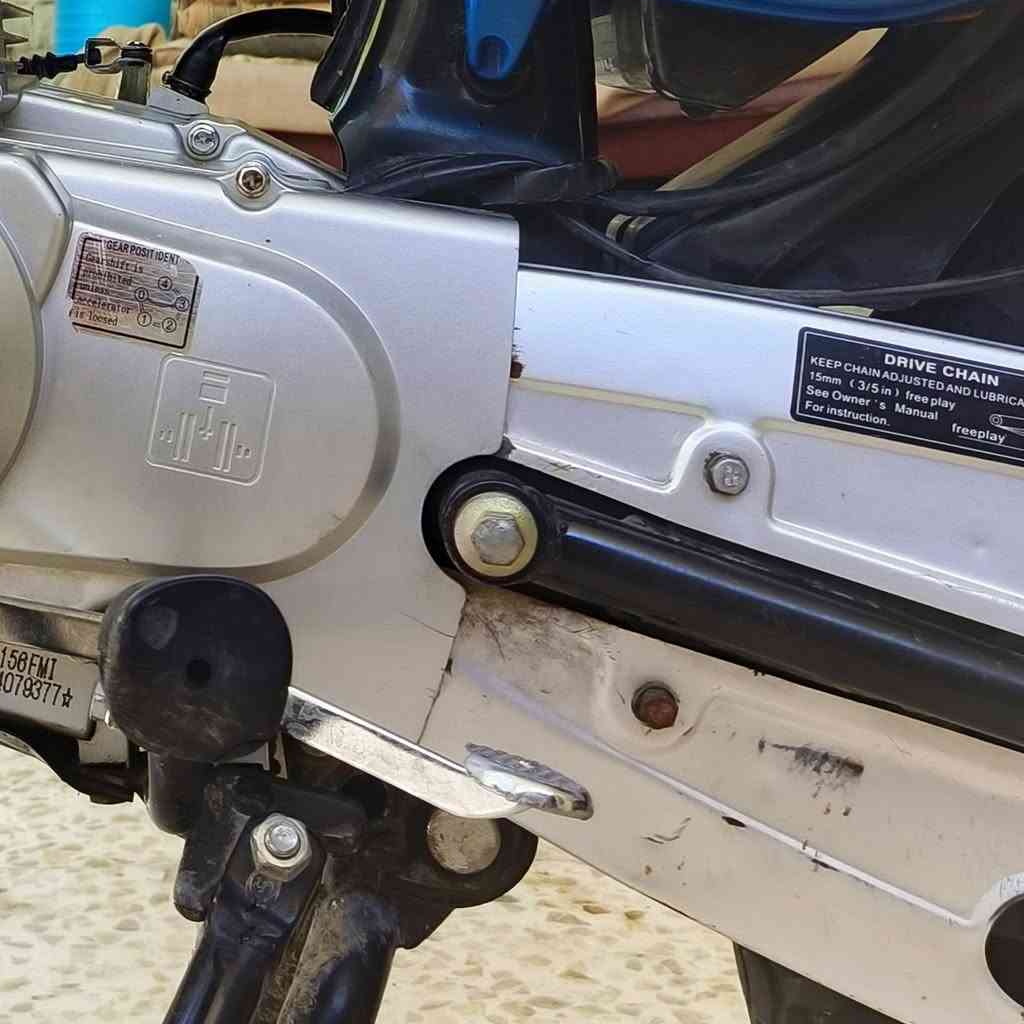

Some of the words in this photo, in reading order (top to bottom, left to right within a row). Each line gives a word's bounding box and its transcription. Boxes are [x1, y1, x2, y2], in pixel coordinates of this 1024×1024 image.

[106, 239, 130, 255] GEAR
[810, 355, 842, 369] KEEP
[843, 362, 881, 378] CHAIN
[881, 370, 945, 391] ADJUSTED
[945, 383, 972, 397] AND
[973, 389, 1024, 408] LUBRICA
[884, 353, 937, 374] DRIVE
[942, 365, 1000, 387] CHAIN
[805, 384, 830, 399] See
[894, 402, 939, 421] Manual
[805, 400, 825, 413] For
[809, 371, 842, 385] 15mm
[905, 390, 929, 404] free
[930, 397, 956, 412] play
